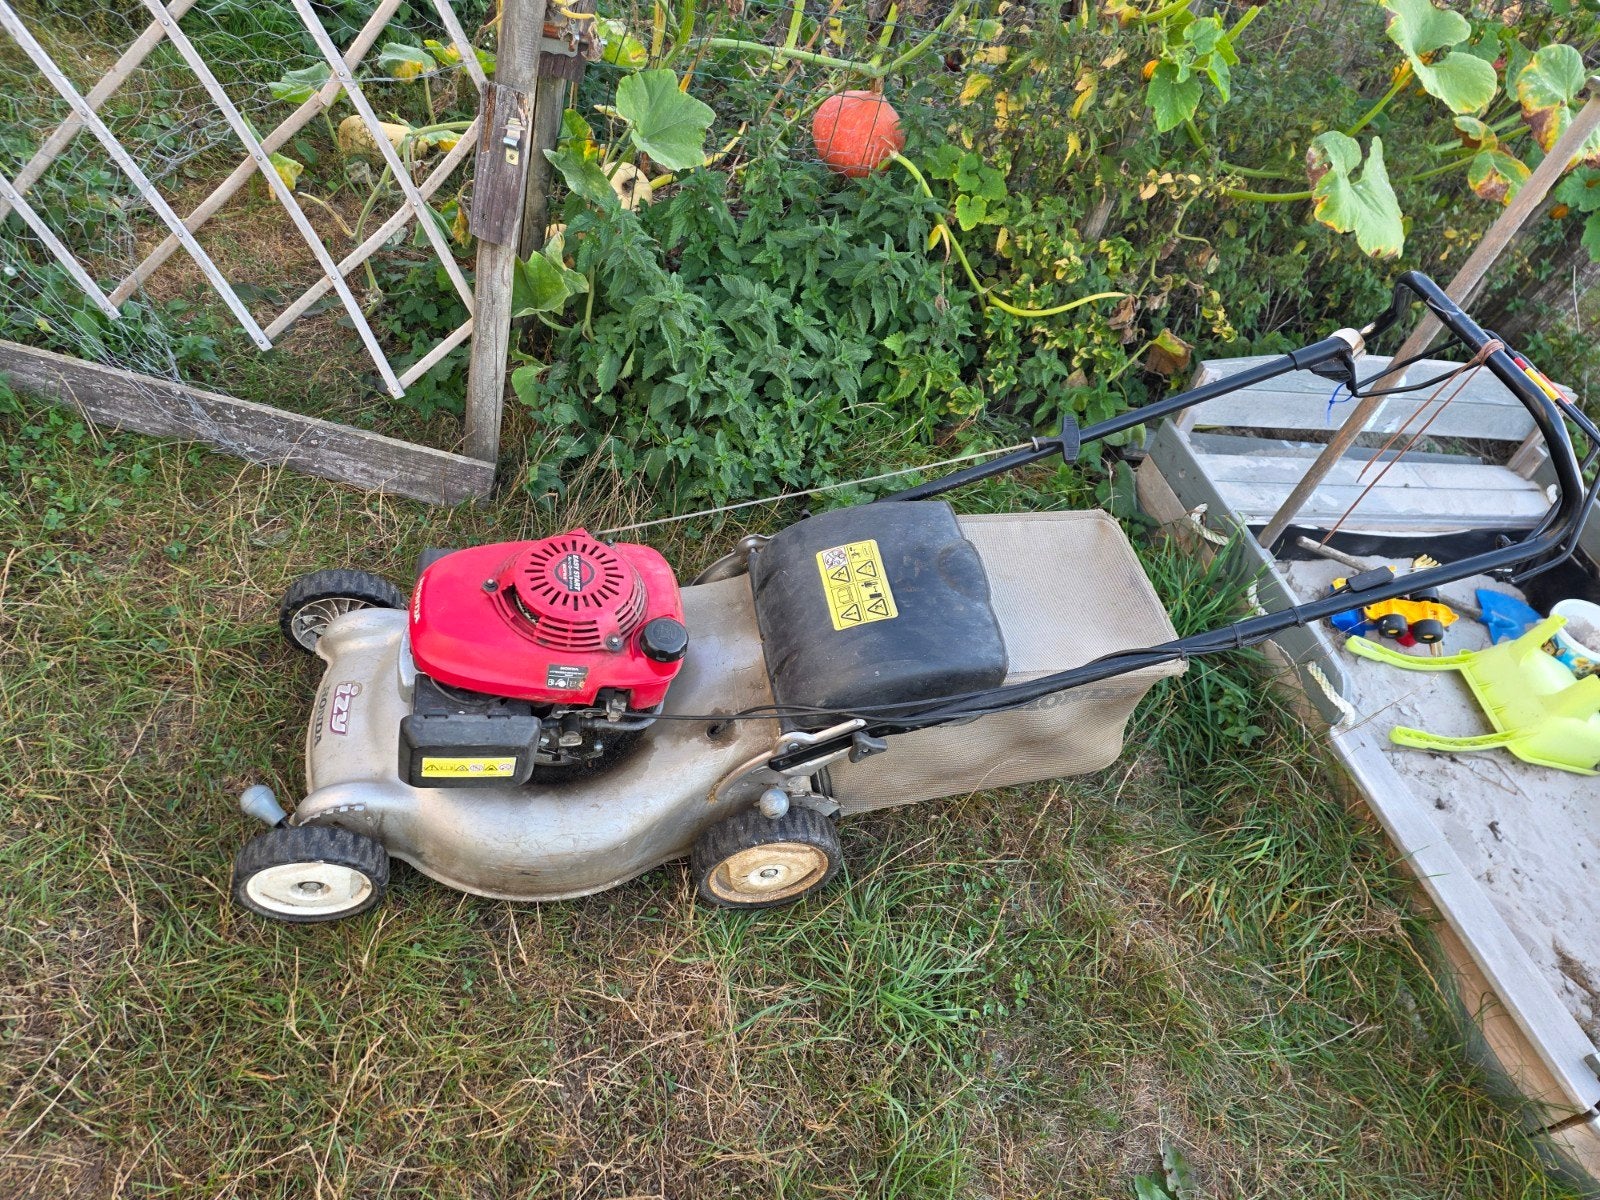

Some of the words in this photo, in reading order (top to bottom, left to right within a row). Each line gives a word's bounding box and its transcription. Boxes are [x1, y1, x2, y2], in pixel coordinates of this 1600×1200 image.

[572, 554, 580, 570] EASY
[573, 570, 581, 592] START
[313, 685, 331, 748] HONDA
[331, 683, 360, 734] izy
